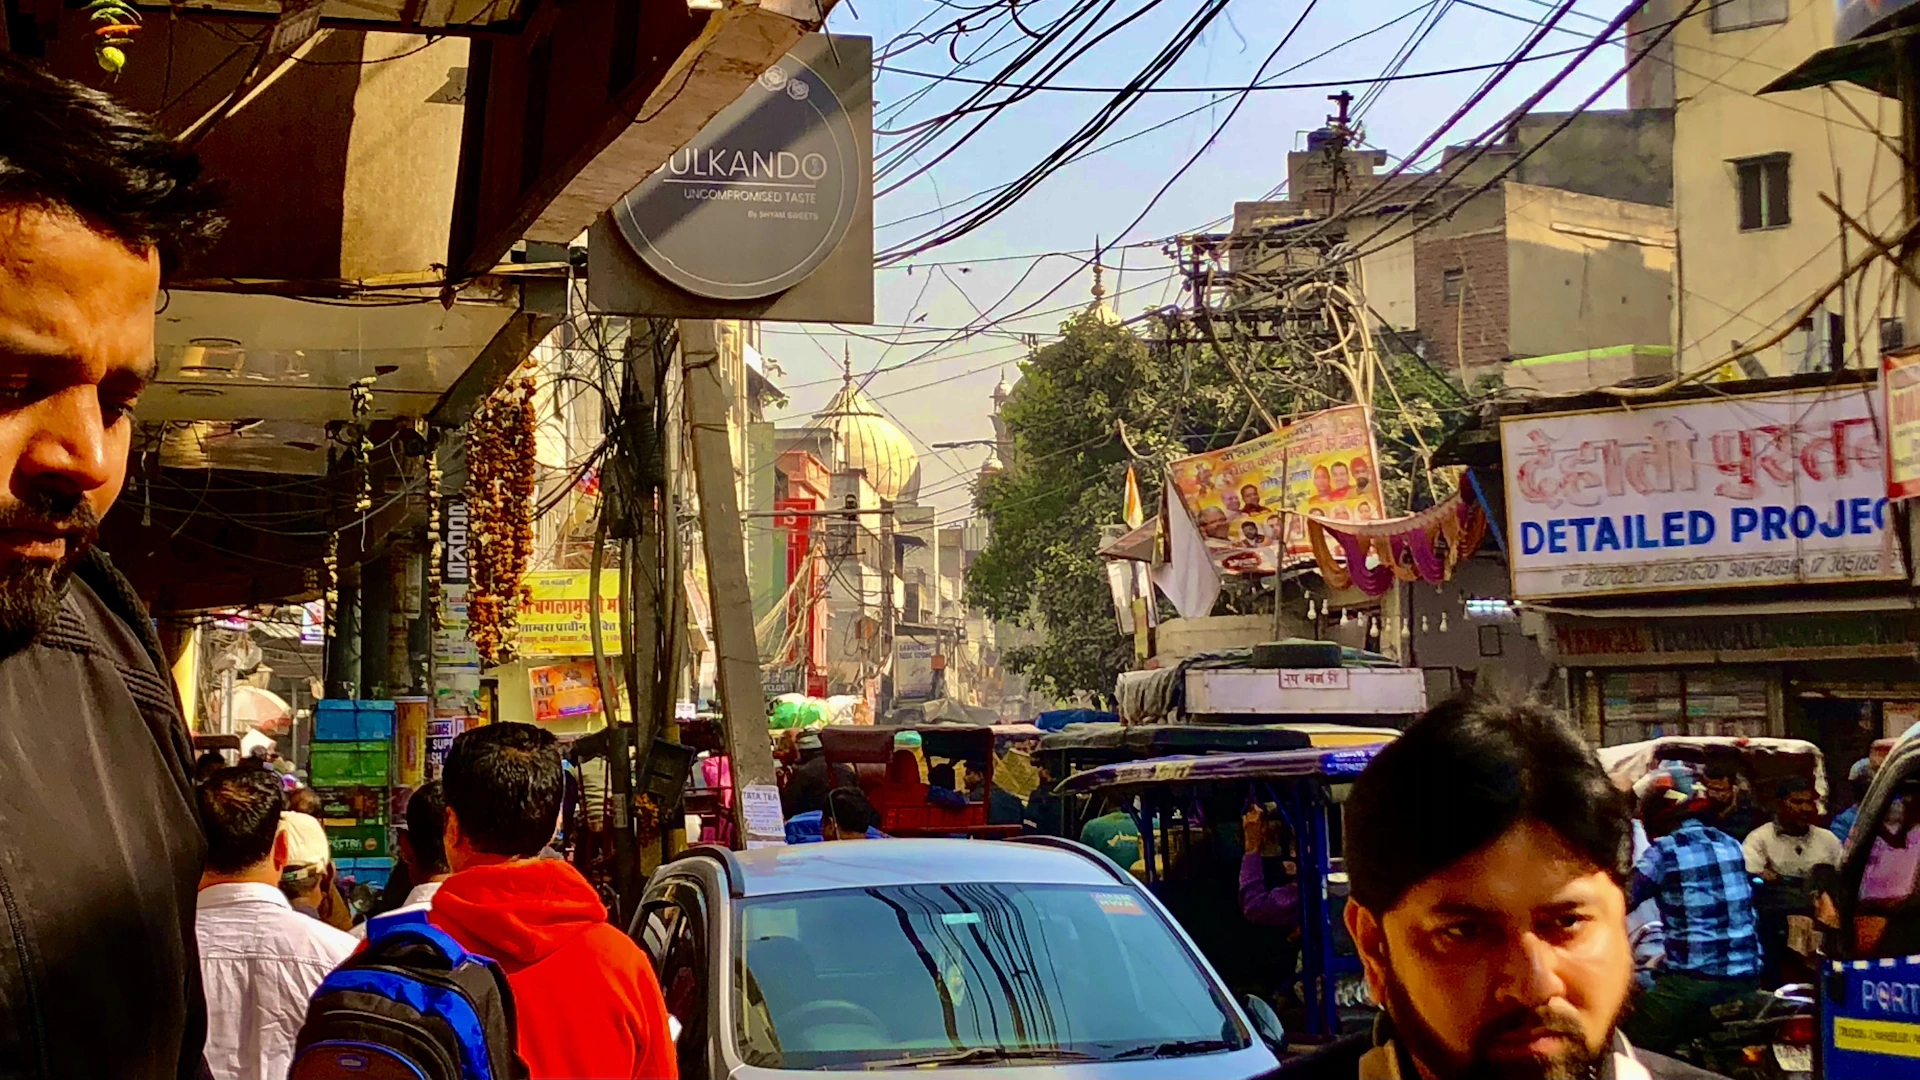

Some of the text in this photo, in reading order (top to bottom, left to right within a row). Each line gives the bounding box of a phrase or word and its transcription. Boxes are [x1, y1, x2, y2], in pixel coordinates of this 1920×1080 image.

[684, 188, 817, 204] UNCOMPROMISED TASTE
[1520, 509, 1716, 555] DETAILED
[743, 791, 778, 801] TATA TEA
